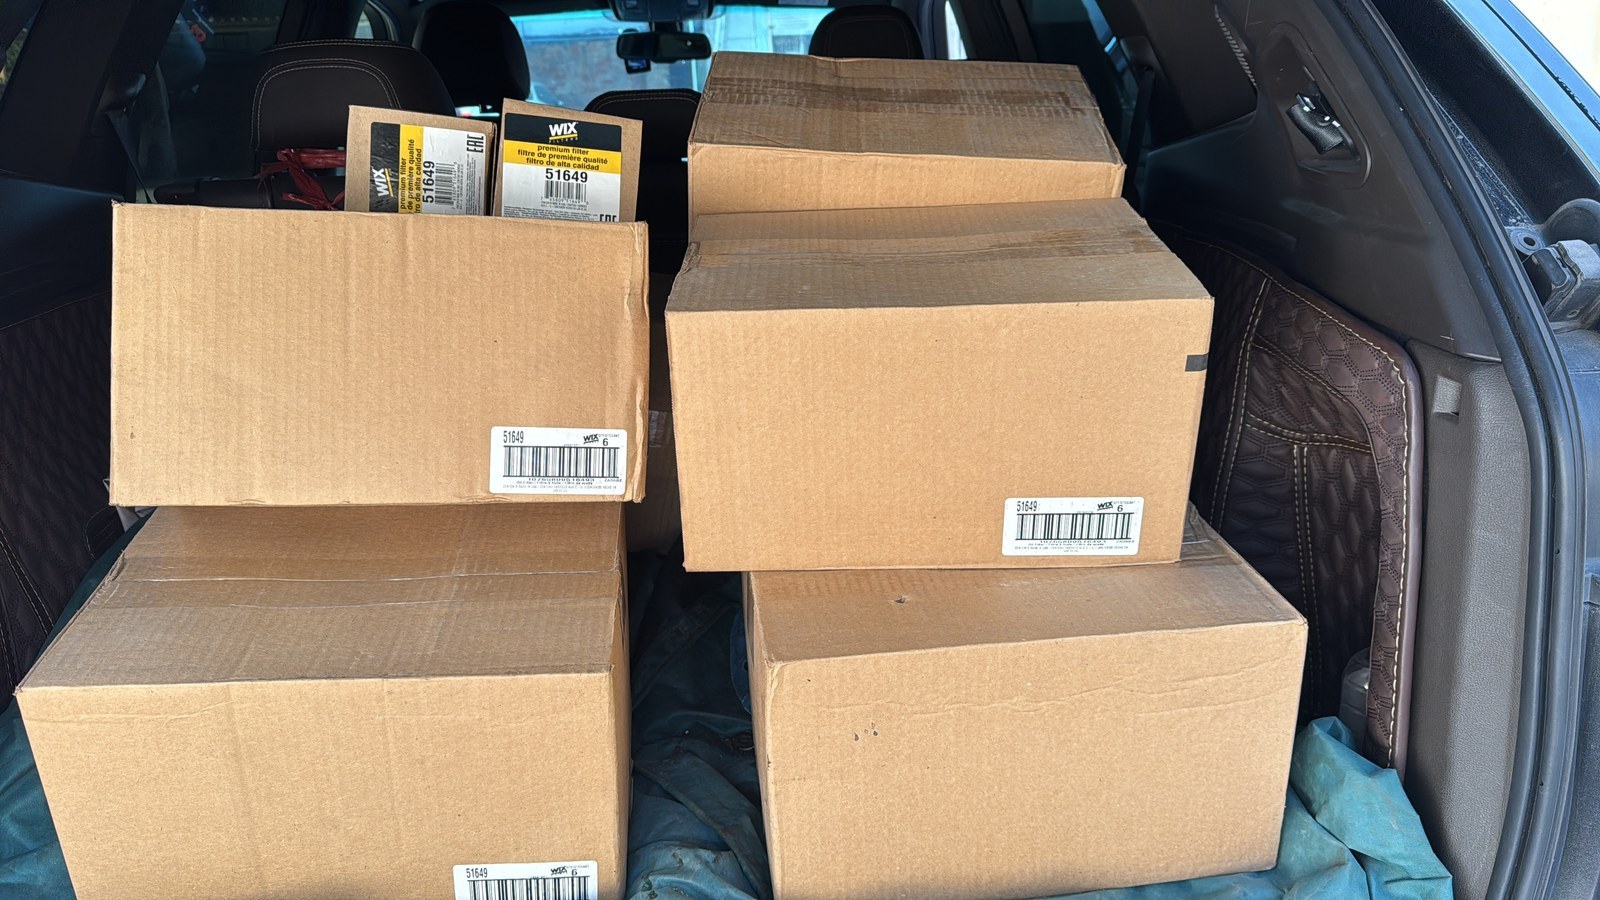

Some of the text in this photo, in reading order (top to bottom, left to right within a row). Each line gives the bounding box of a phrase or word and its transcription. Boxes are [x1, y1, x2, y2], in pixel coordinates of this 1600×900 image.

[549, 121, 578, 137] WIX
[408, 138, 416, 165] qualité
[517, 149, 535, 157] filtre
[548, 153, 581, 163] première
[583, 157, 608, 165] qualité
[537, 145, 589, 155] premium filter
[414, 148, 422, 176] calidad
[526, 157, 544, 165] filtro
[572, 163, 600, 171] calidad
[371, 166, 390, 197] WIX
[422, 160, 435, 204] 51649
[545, 167, 588, 183] 51649
[407, 166, 417, 199] première
[414, 177, 422, 191] alta
[415, 192, 421, 202] de
[407, 200, 414, 210] de
[503, 430, 524, 444] 51649
[583, 433, 599, 442] WIX
[602, 437, 609, 447] 6
[1016, 500, 1038, 512] 51649
[1117, 504, 1123, 513] 6
[466, 867, 488, 879] 51649
